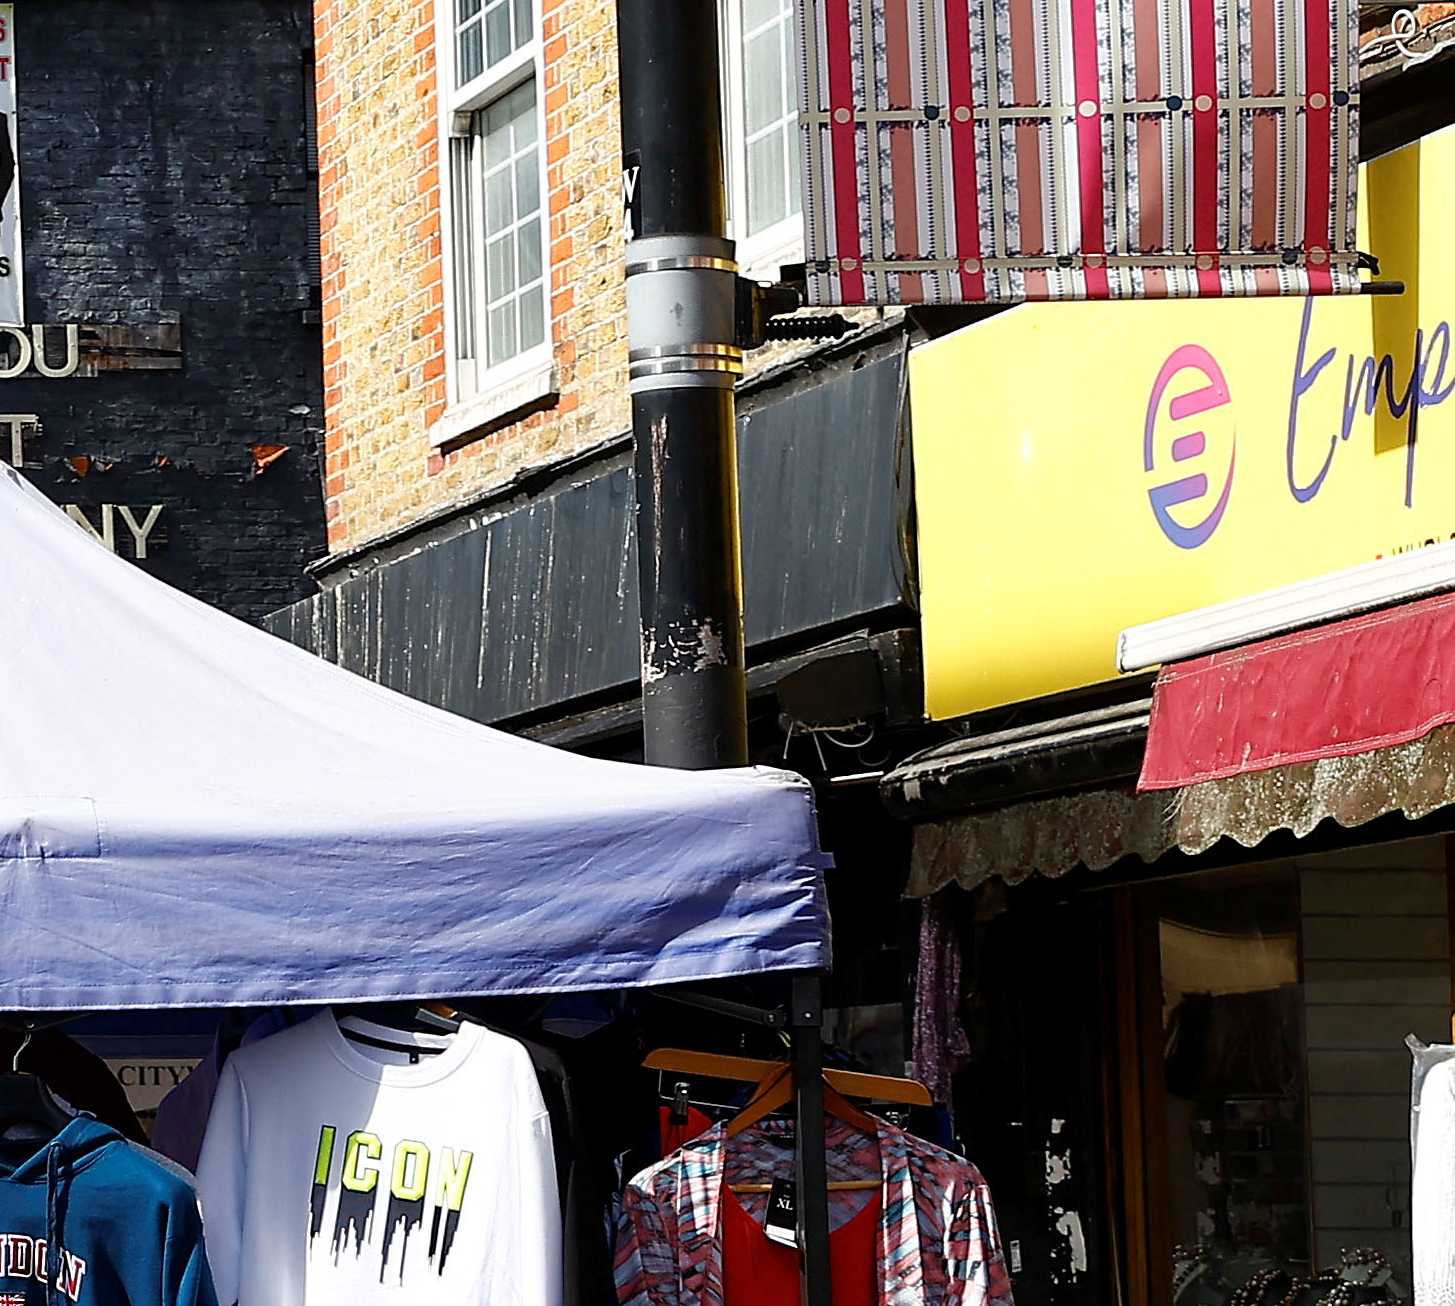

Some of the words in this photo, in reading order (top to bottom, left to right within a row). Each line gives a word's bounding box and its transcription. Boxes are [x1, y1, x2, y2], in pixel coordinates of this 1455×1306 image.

[117, 1065, 193, 1086] CITY
[310, 1124, 473, 1240] ICON
[776, 1197, 794, 1211] XL
